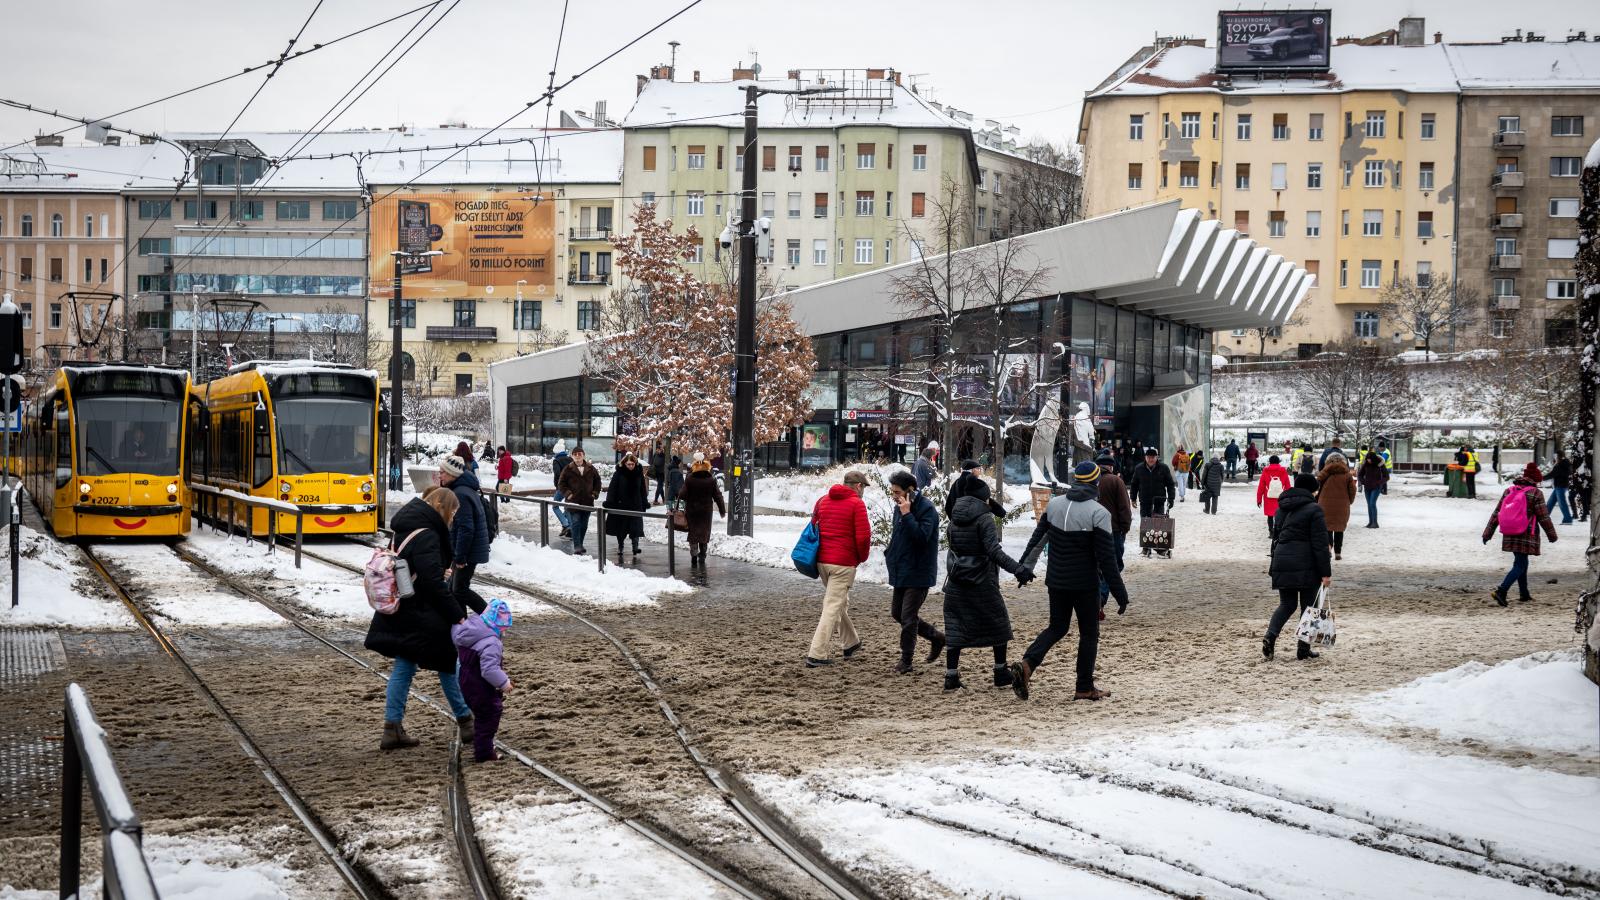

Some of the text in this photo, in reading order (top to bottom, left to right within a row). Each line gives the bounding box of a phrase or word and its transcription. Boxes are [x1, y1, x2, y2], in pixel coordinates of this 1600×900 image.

[1226, 23, 1271, 32] TOYOTA
[1226, 33, 1255, 43] bZ4X
[454, 200, 511, 211] FOGADD MEG,
[454, 211, 524, 221] HOGY ESÉLYT ADSZ
[470, 256, 545, 268] 50 MILLIÓ FORINT
